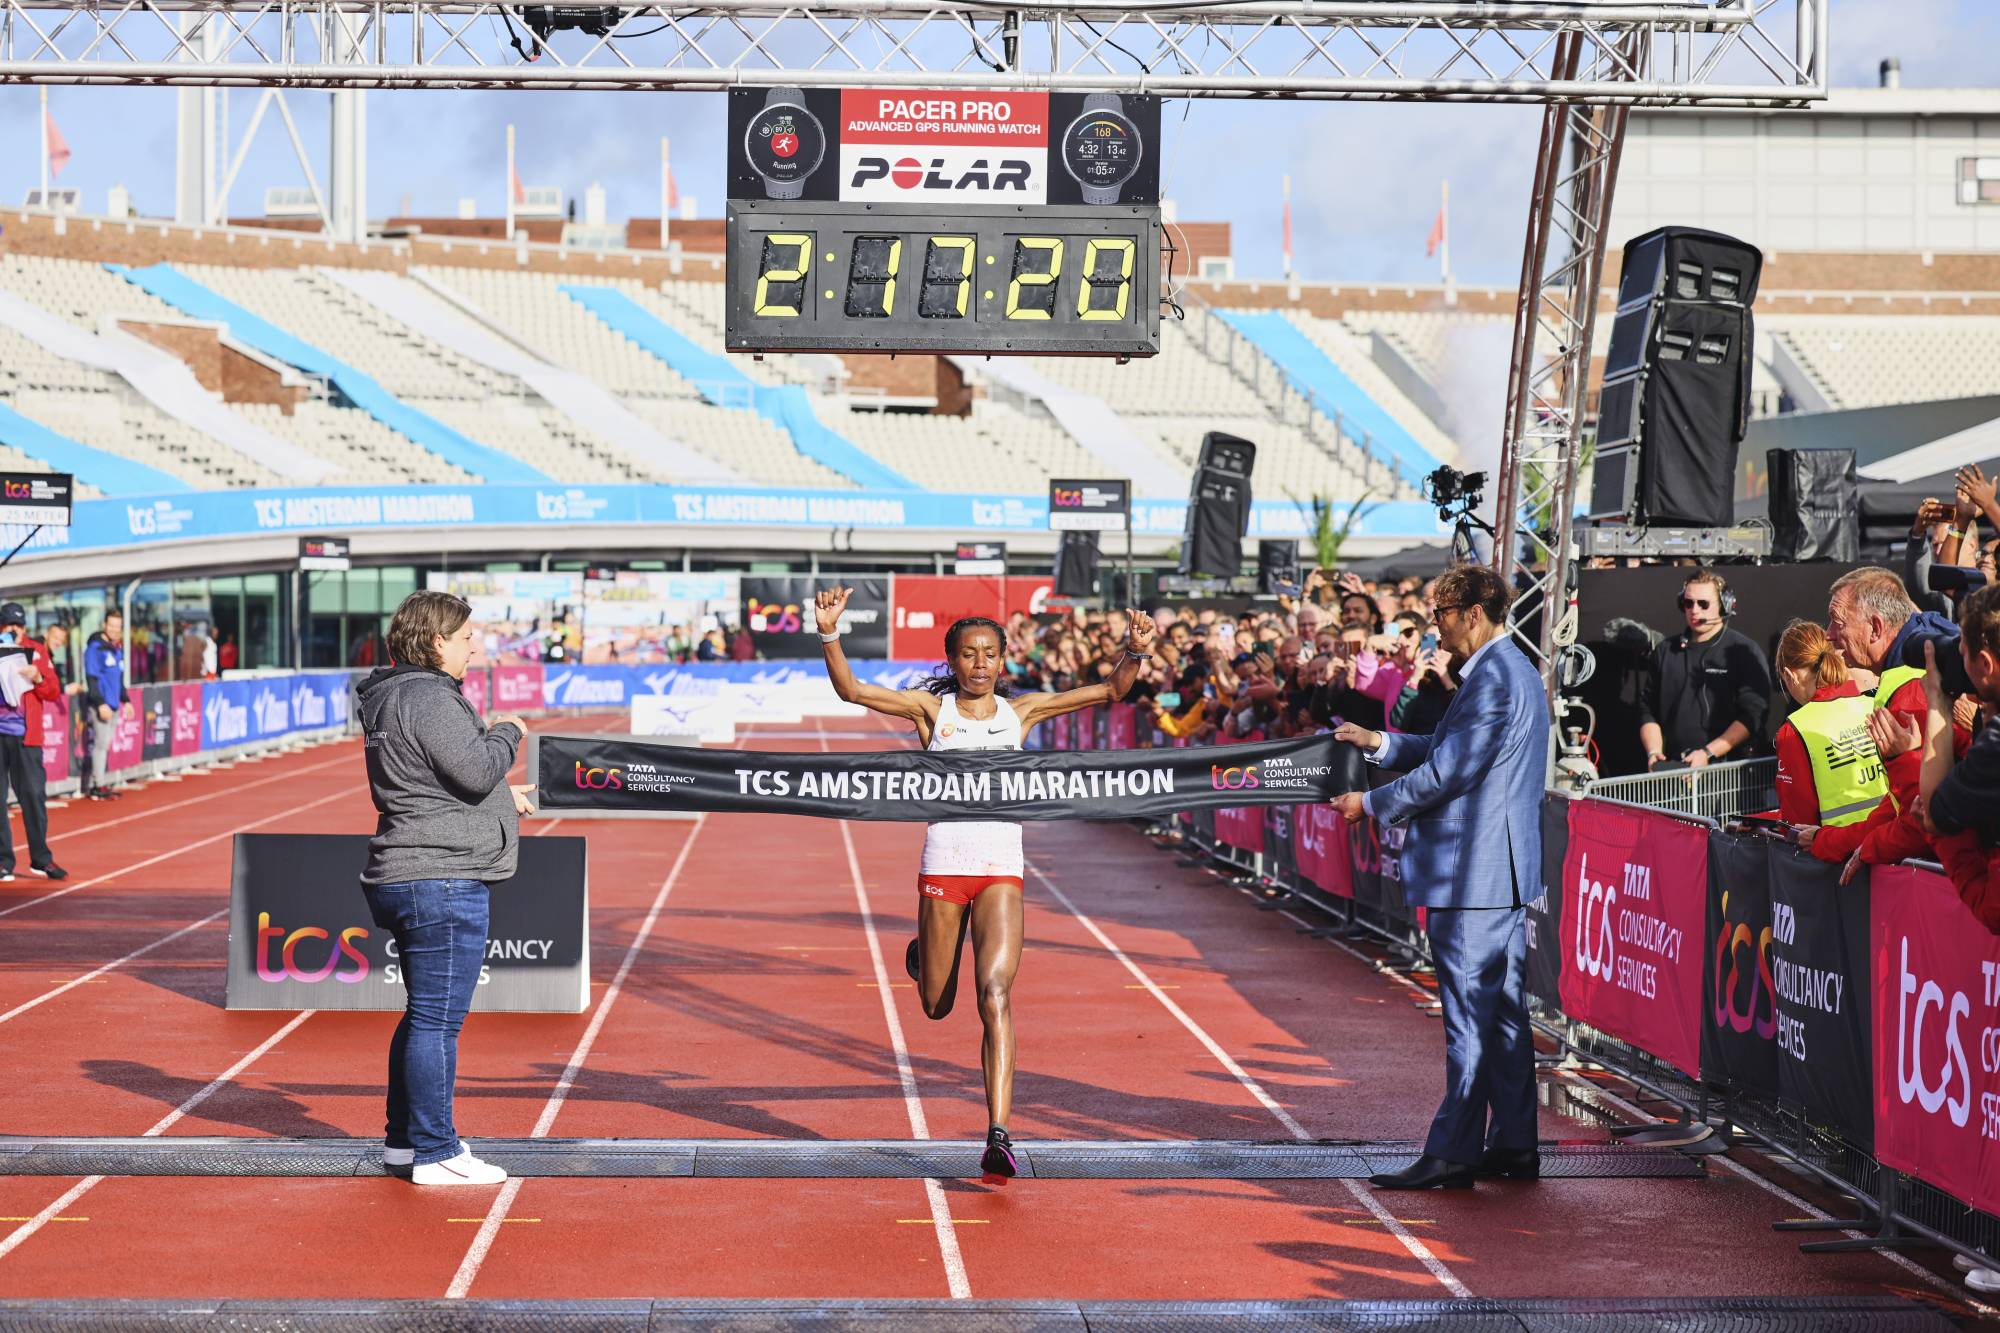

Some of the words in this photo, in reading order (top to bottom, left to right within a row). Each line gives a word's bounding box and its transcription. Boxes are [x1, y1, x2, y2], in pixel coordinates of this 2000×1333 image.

[879, 100, 956, 119] PACER
[962, 102, 1011, 120] PRO
[848, 121, 913, 132] ADVANCED
[915, 123, 940, 133] GPS
[942, 124, 996, 134] RUNNING
[999, 124, 1041, 135] WATCH
[1094, 127, 1111, 137] 168
[1078, 144, 1099, 154] 4:32
[1106, 145, 1127, 155] 13.42
[772, 160, 797, 170] Running
[851, 157, 1032, 191] POLAR
[1087, 165, 1116, 176] 01:05:27
[4, 480, 31, 498] tcs
[1055, 488, 1082, 506] tcs
[254, 498, 284, 528] TCS
[672, 494, 705, 520] TCS
[627, 763, 656, 773] TATA
[1263, 758, 1293, 768] TATA
[1264, 766, 1332, 778] CONSULTANCY
[575, 761, 623, 790] tcs
[627, 773, 696, 784] CONSULTANCY
[735, 769, 790, 796] TCS
[797, 770, 992, 803] AMSTERDAM
[1000, 767, 1175, 801] MARATHON
[1211, 765, 1260, 790] tcs
[1264, 778, 1308, 788] SERVICES
[627, 783, 671, 793] SERVICES
[1623, 862, 1651, 901] TATA
[1576, 852, 1616, 983] tcs
[256, 911, 370, 984] tcs
[1715, 890, 1776, 1041] tcs
[1617, 954, 1657, 1001] SERVICES
[1773, 955, 1844, 1015] ONSULTANCY
[1897, 935, 1971, 1128] tcs
